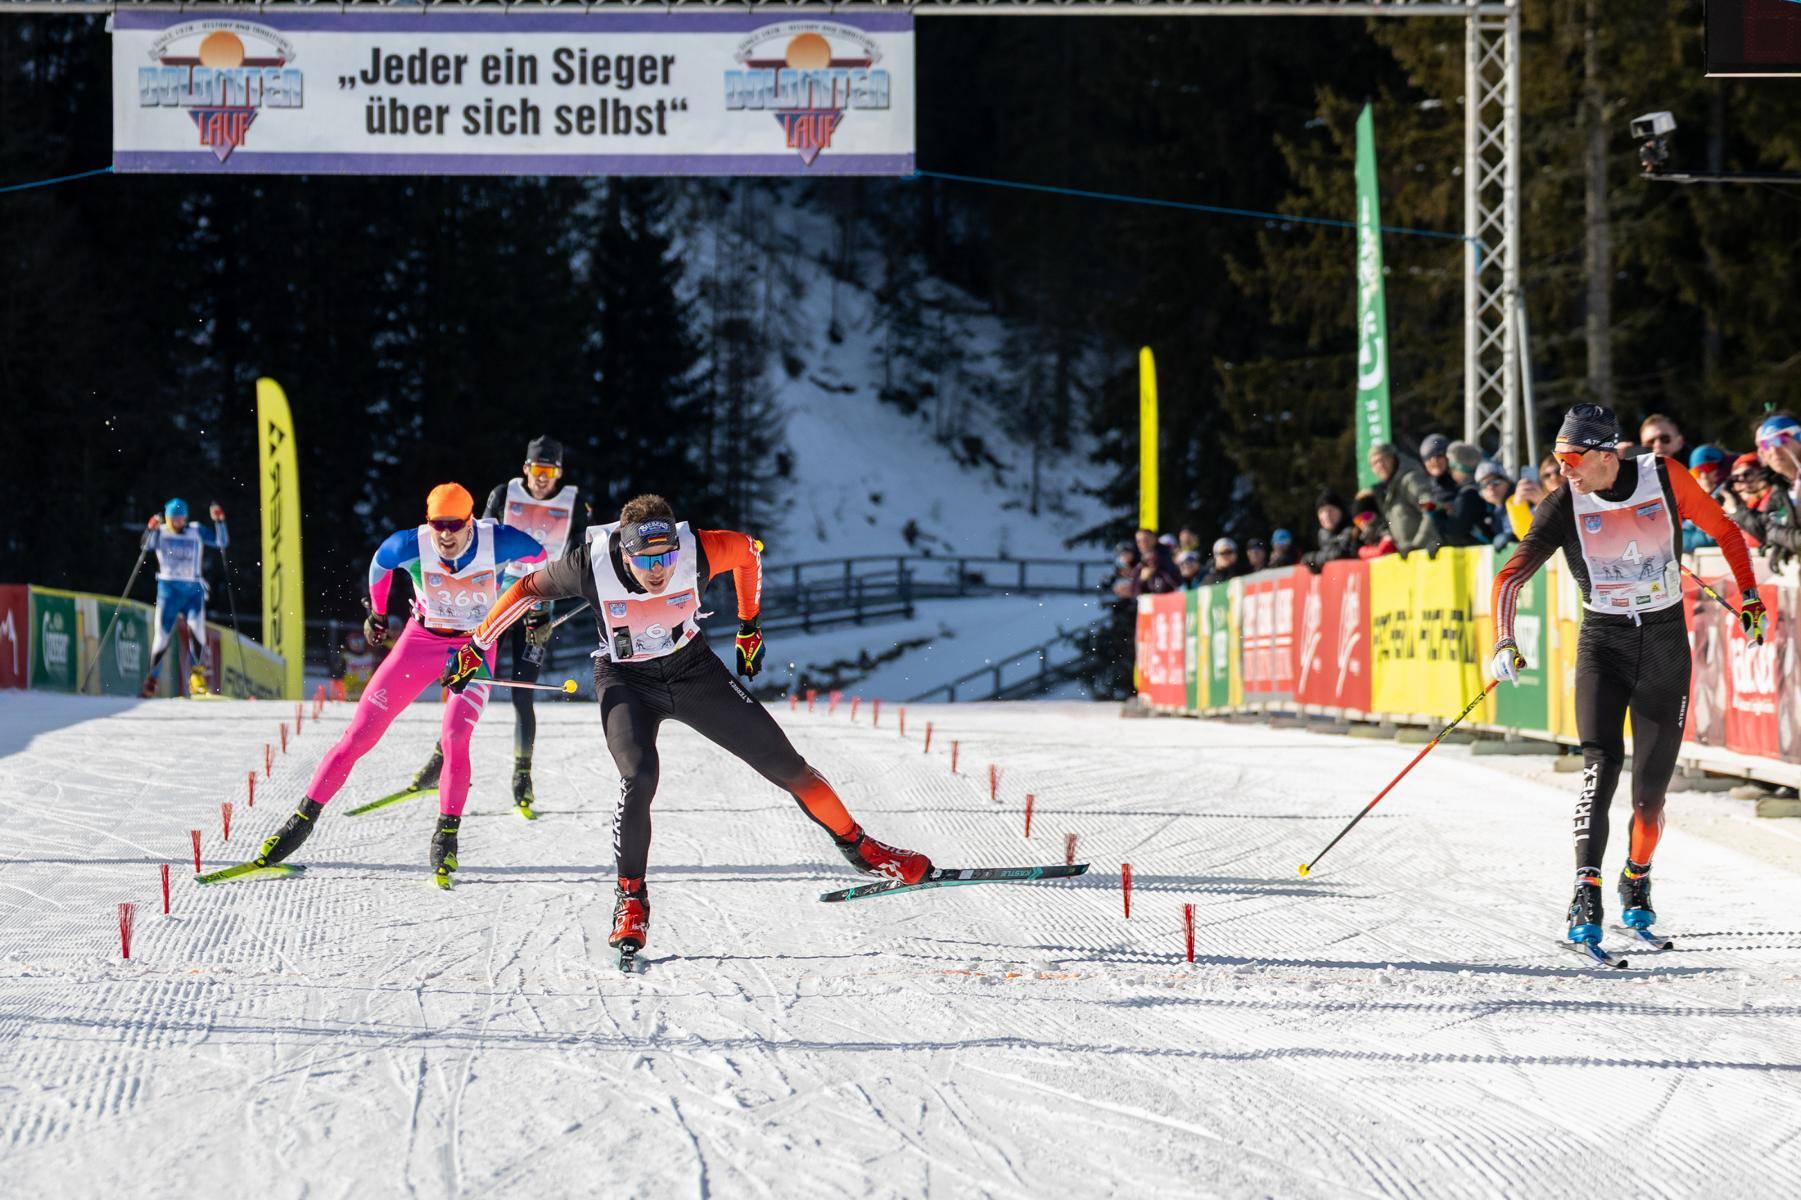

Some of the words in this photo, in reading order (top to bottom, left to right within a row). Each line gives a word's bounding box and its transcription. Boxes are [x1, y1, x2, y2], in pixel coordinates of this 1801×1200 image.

[201, 21, 233, 30] HISTORY
[235, 23, 250, 32] AND
[252, 26, 289, 48] TRADITION
[481, 47, 538, 86] ein
[552, 47, 676, 91] Sieger
[199, 111, 249, 146] LAUF
[366, 96, 449, 136] über
[462, 97, 541, 136] sich
[785, 114, 837, 149] LAUF
[1622, 540, 1642, 565] 4
[437, 589, 488, 607] 360
[646, 623, 666, 639] 6
[1573, 764, 1598, 847] TERREX
